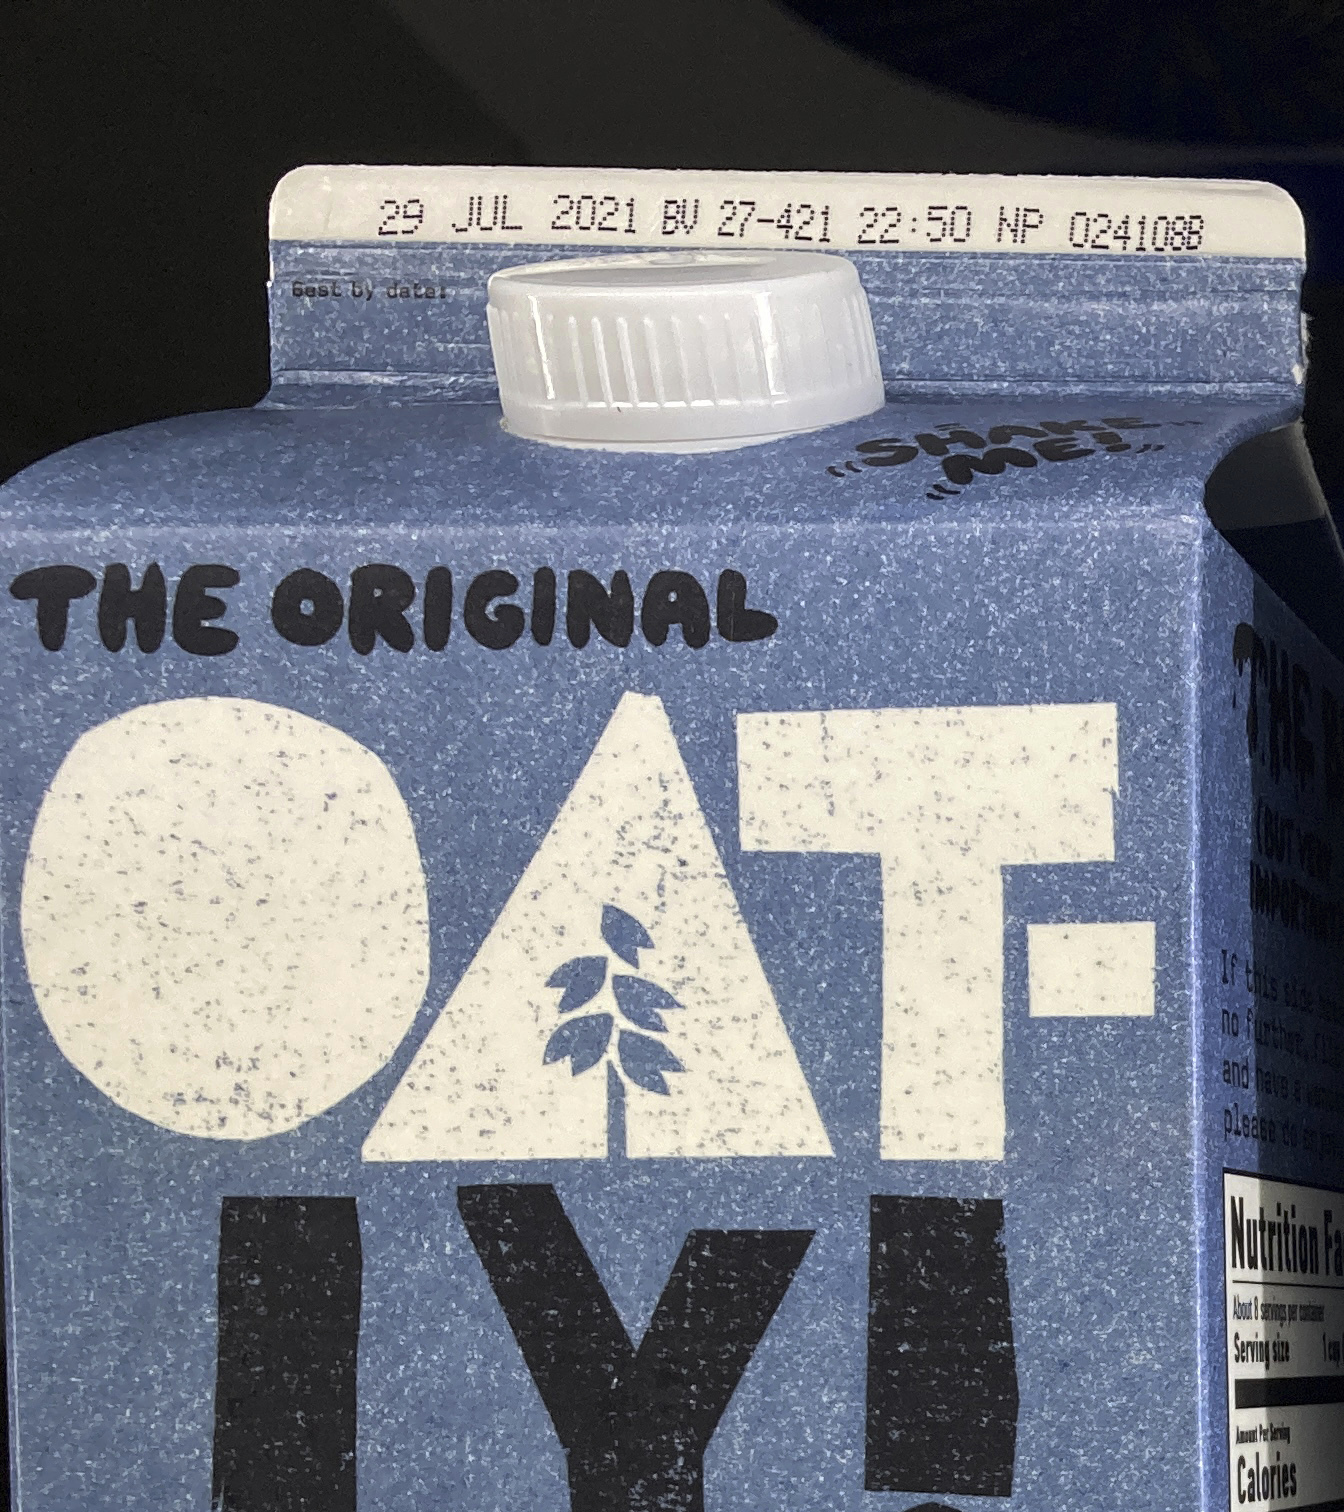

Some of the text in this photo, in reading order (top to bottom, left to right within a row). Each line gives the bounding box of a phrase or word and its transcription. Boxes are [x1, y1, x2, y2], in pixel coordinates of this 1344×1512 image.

[378, 200, 425, 236] 29
[452, 195, 523, 232] JUL
[551, 194, 636, 234] 2021
[661, 198, 700, 235] BV
[718, 200, 831, 243] 27-421
[857, 205, 972, 244] 22:50
[997, 205, 1045, 244] NP
[350, 280, 377, 302] by
[10, 562, 779, 656] THE ORIGINAL
[20, 691, 1157, 1162] OAT-
[1221, 948, 1238, 986] If
[1221, 1008, 1239, 1037] no
[1222, 1056, 1249, 1089] and
[1223, 1102, 1276, 1144] please
[1230, 1195, 1319, 1276] Nutrition
[1234, 1331, 1290, 1371] Serving size
[1237, 1450, 1297, 1504] Calories
